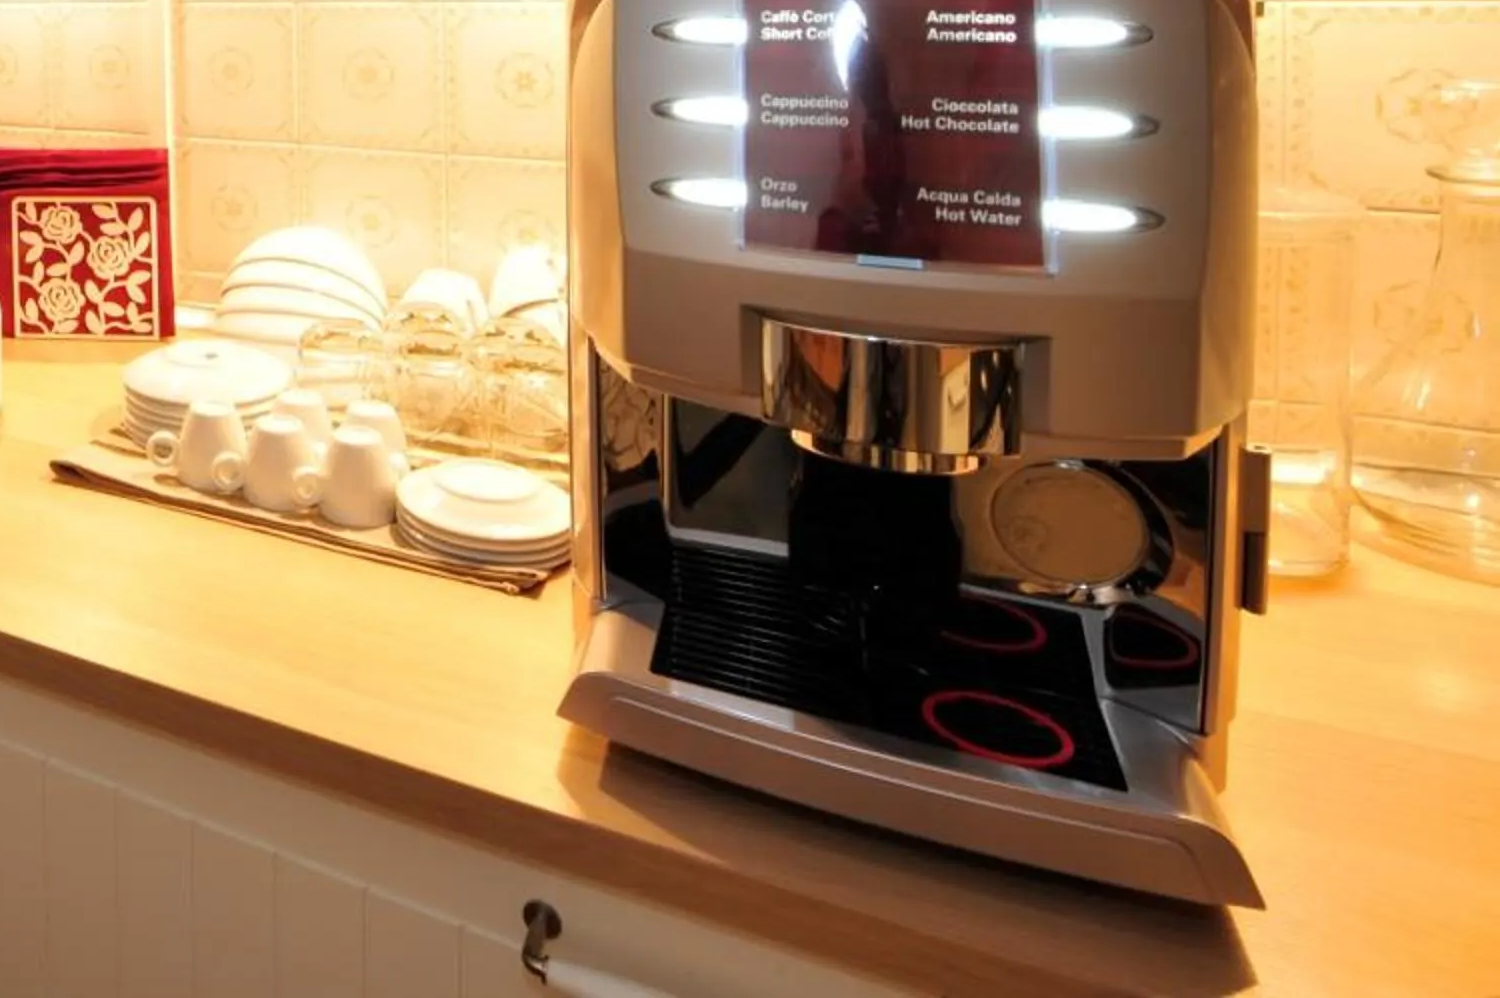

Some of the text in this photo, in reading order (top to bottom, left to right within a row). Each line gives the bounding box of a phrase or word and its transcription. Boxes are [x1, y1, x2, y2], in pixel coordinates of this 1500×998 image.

[802, 10, 845, 23] Cort
[926, 10, 1017, 25] Americano
[761, 27, 802, 41] Short
[926, 27, 1018, 43] Americano
[761, 93, 849, 110] Cappuccino
[932, 97, 1019, 115] Cioccolata
[761, 111, 849, 128] Cappuccino
[901, 115, 1019, 134] Hot Chocolate
[761, 177, 798, 192] Orzo
[761, 194, 809, 213] Barley
[917, 187, 1021, 207] Acqua Calda
[935, 206, 1022, 226] Hot Water
